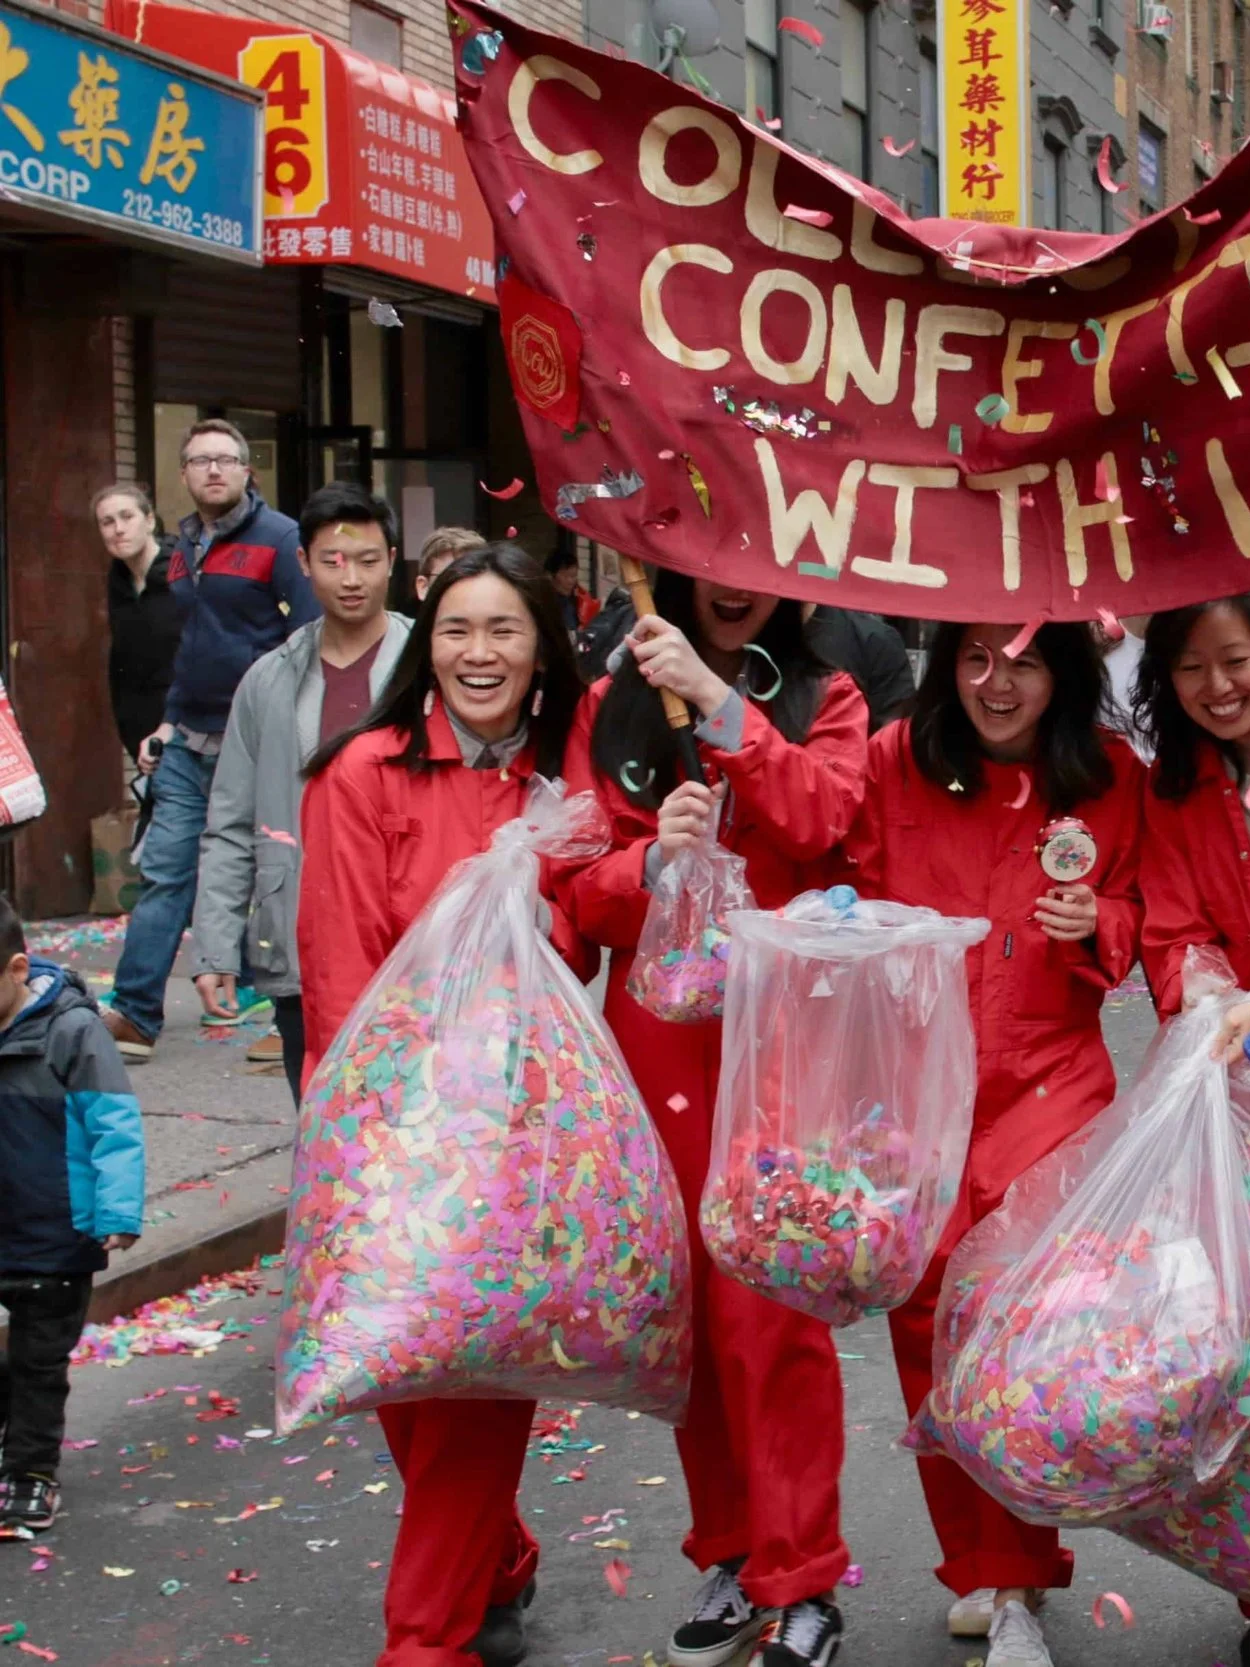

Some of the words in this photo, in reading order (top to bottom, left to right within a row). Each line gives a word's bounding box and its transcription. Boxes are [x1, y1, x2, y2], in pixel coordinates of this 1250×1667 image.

[0, 150, 90, 200] CORP
[256, 50, 313, 198] 46
[508, 54, 1202, 291] COLL
[122, 188, 243, 247] 212-962-3388
[755, 438, 1134, 590] WITH
